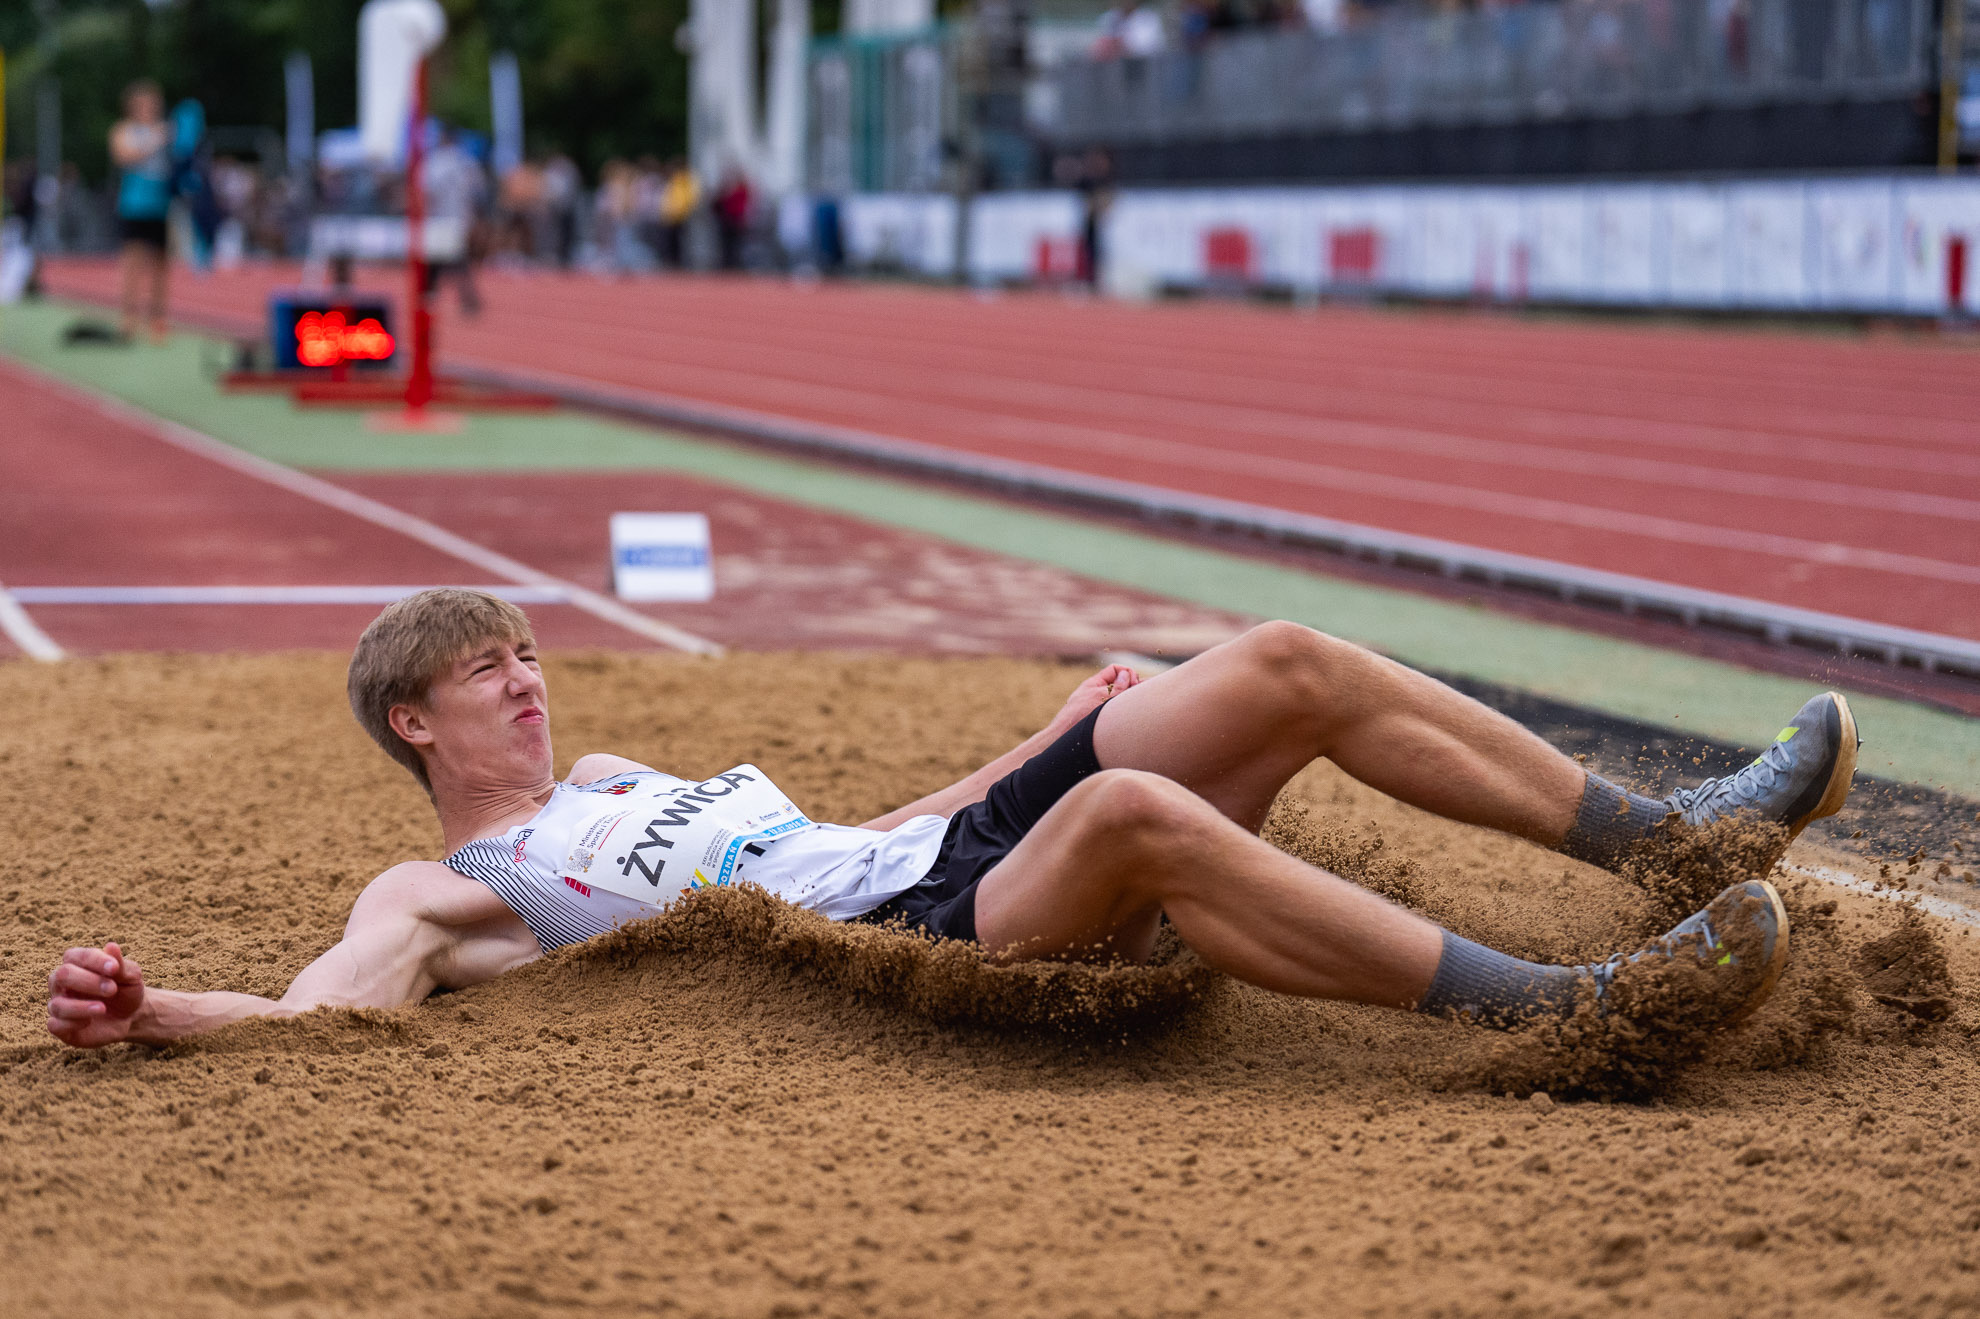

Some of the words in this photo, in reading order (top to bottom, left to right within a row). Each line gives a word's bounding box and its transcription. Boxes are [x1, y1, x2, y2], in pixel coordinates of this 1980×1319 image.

[587, 827, 605, 849] Sportu
[617, 772, 755, 887] ŻYWICA
[719, 846, 738, 884] OZNAŃ
